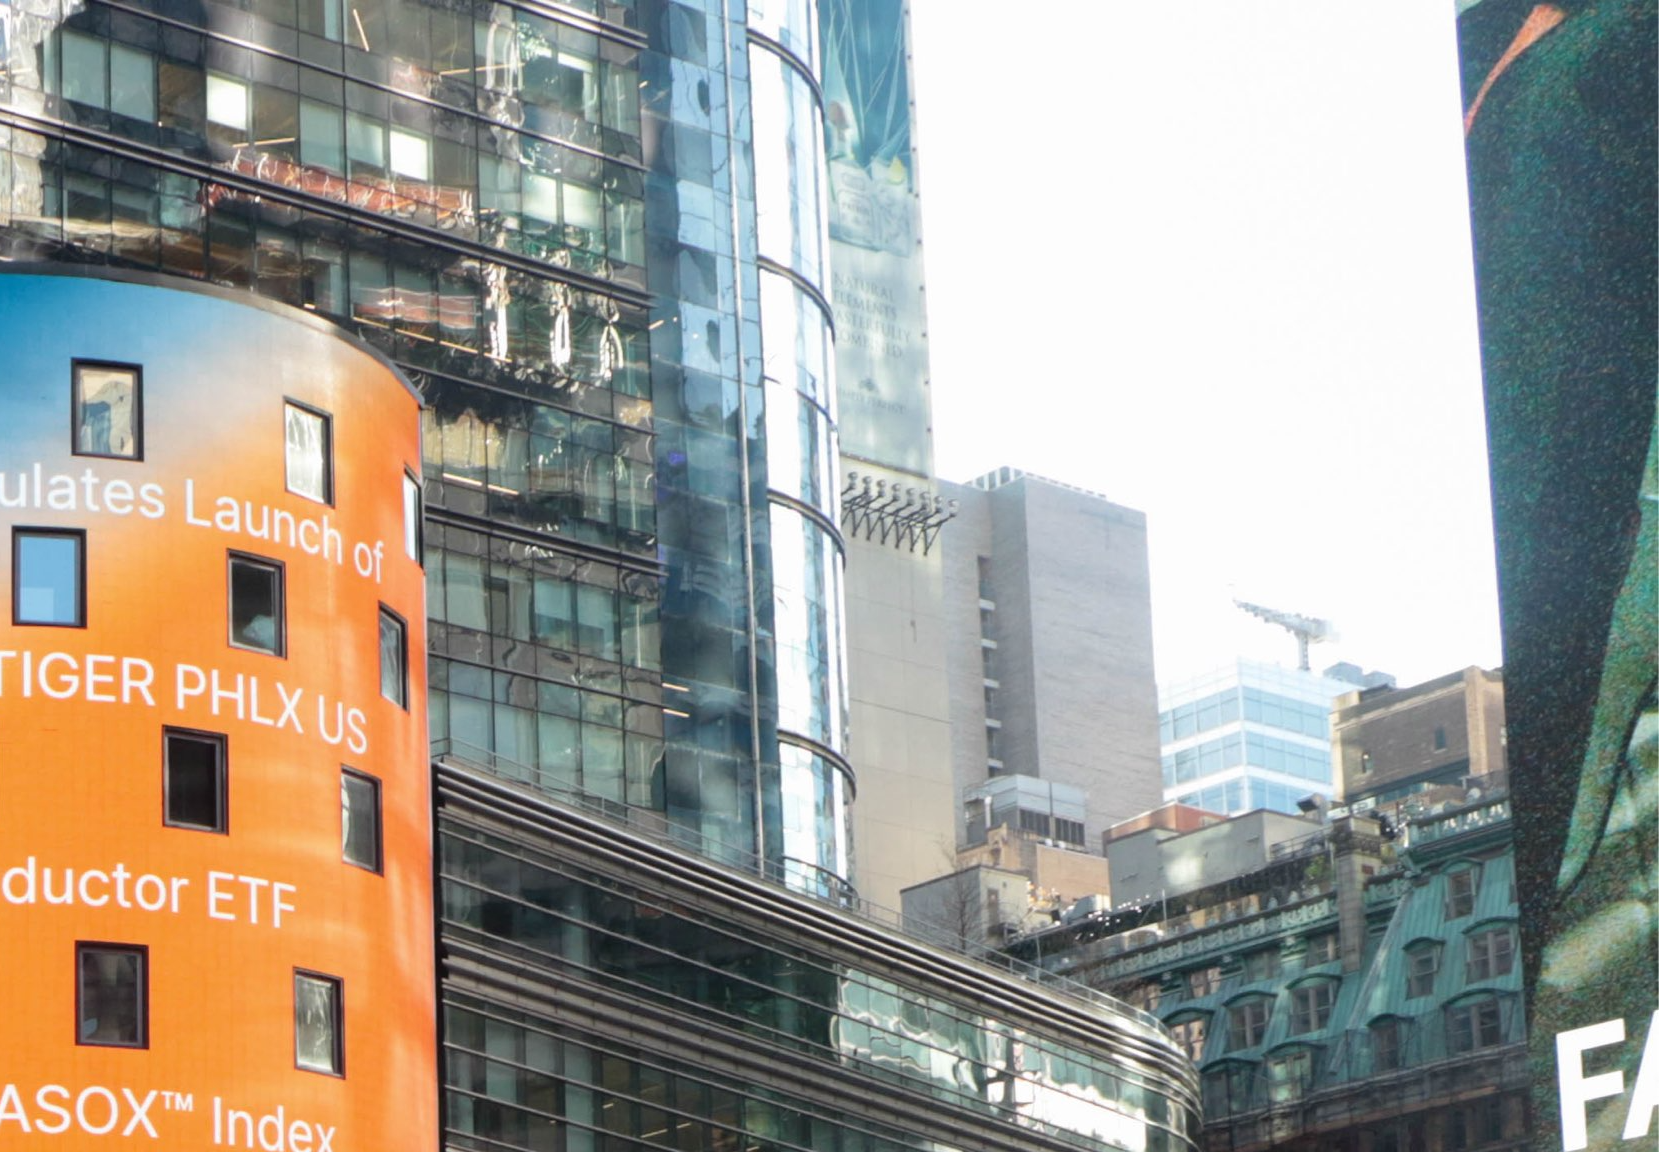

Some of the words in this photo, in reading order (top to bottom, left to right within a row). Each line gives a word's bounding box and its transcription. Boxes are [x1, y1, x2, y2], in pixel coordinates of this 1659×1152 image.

[836, 309, 911, 344] ASTERFULLY
[185, 479, 342, 565] Launch
[353, 539, 385, 584] of
[176, 663, 304, 735] PHLX
[318, 694, 368, 755] US
[207, 870, 297, 929] ETF
